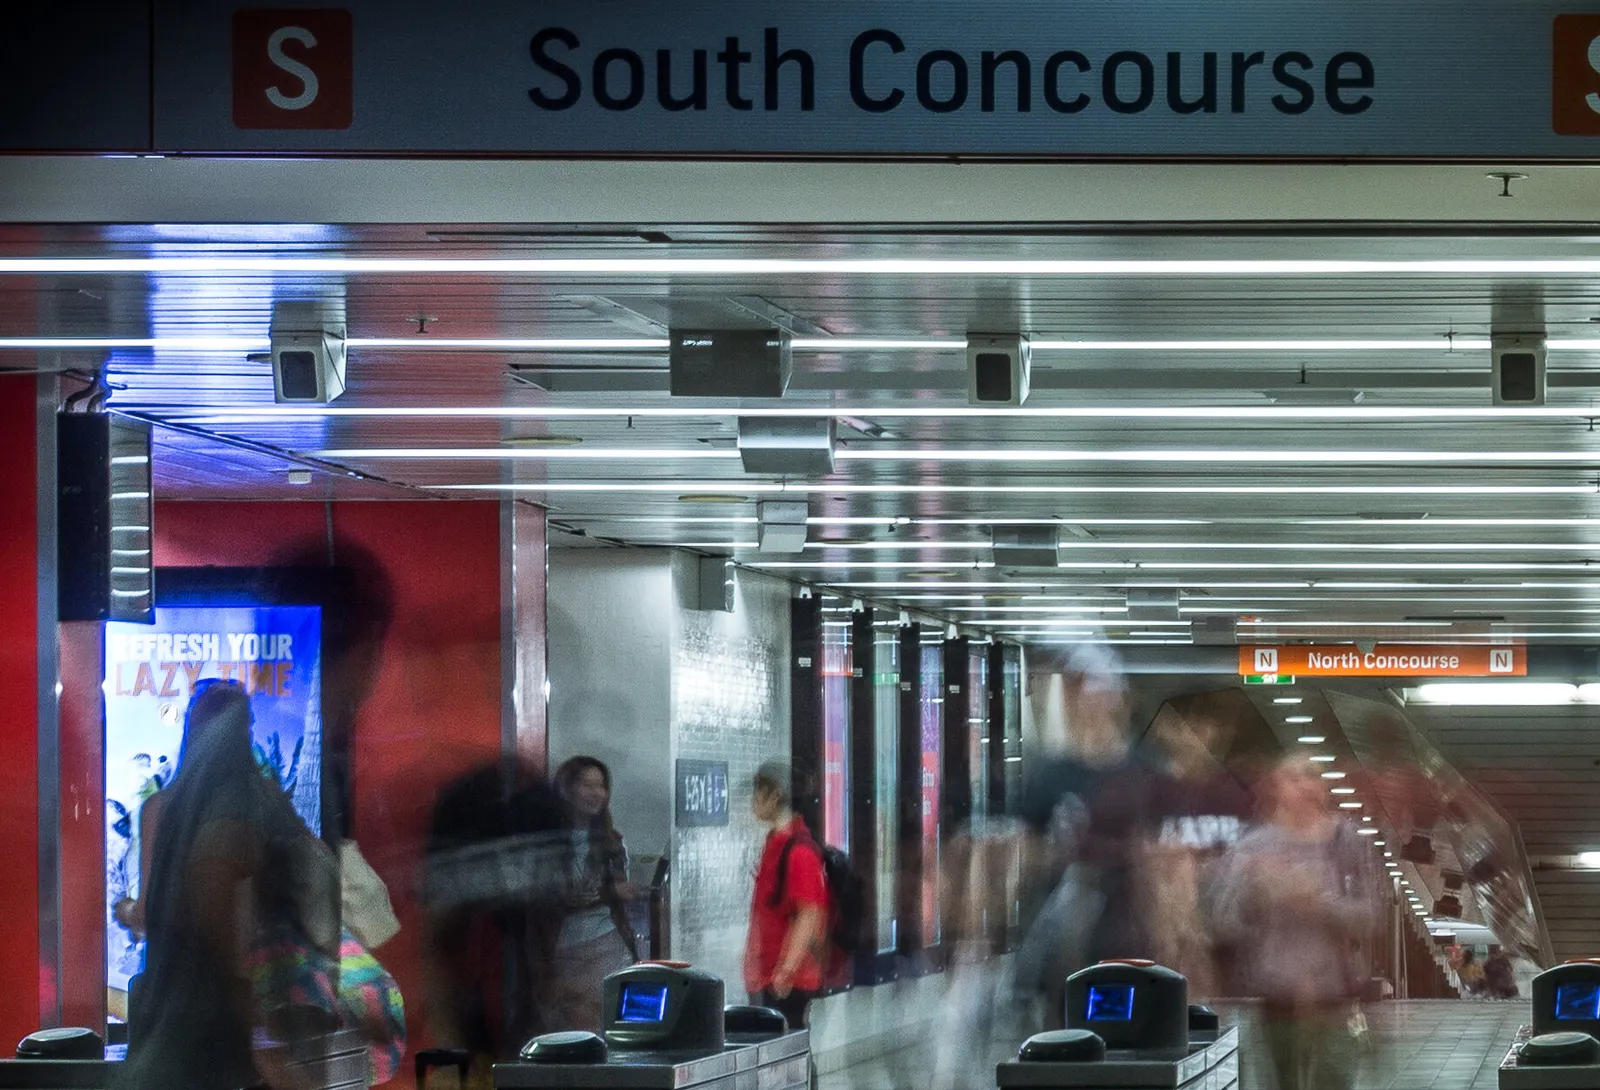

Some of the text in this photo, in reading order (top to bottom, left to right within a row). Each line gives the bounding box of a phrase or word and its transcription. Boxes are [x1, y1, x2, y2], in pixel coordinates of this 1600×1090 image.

[263, 25, 320, 112] S
[527, 26, 816, 113] South
[848, 28, 1377, 116] Concourse
[112, 632, 294, 661] REFRESH YOUR
[1307, 652, 1361, 669] North
[1363, 652, 1460, 669] Concourse
[115, 661, 293, 697] LAZY TIME
